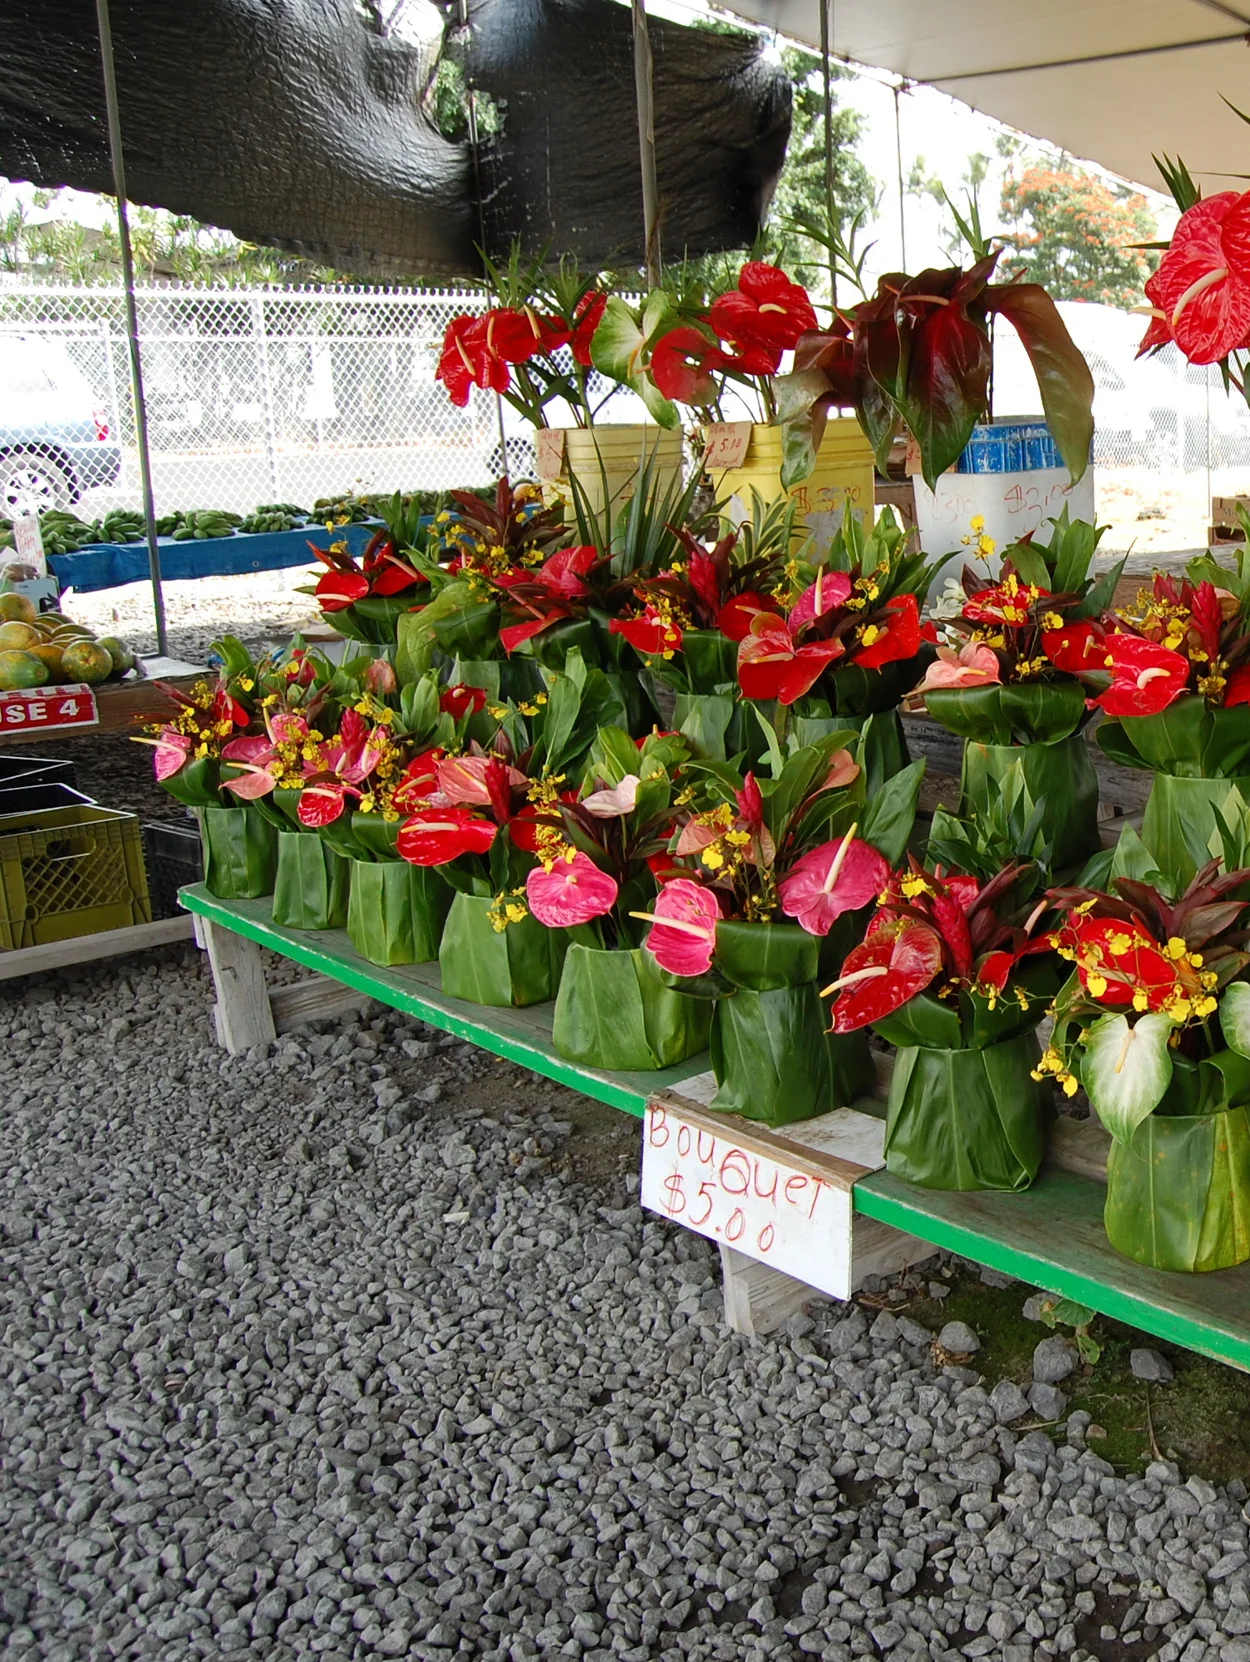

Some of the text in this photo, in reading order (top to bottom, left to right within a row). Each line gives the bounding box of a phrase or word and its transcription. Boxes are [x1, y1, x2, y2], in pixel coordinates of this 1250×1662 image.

[0, 698, 80, 723] SE 4
[659, 1161, 775, 1252] $5.00
